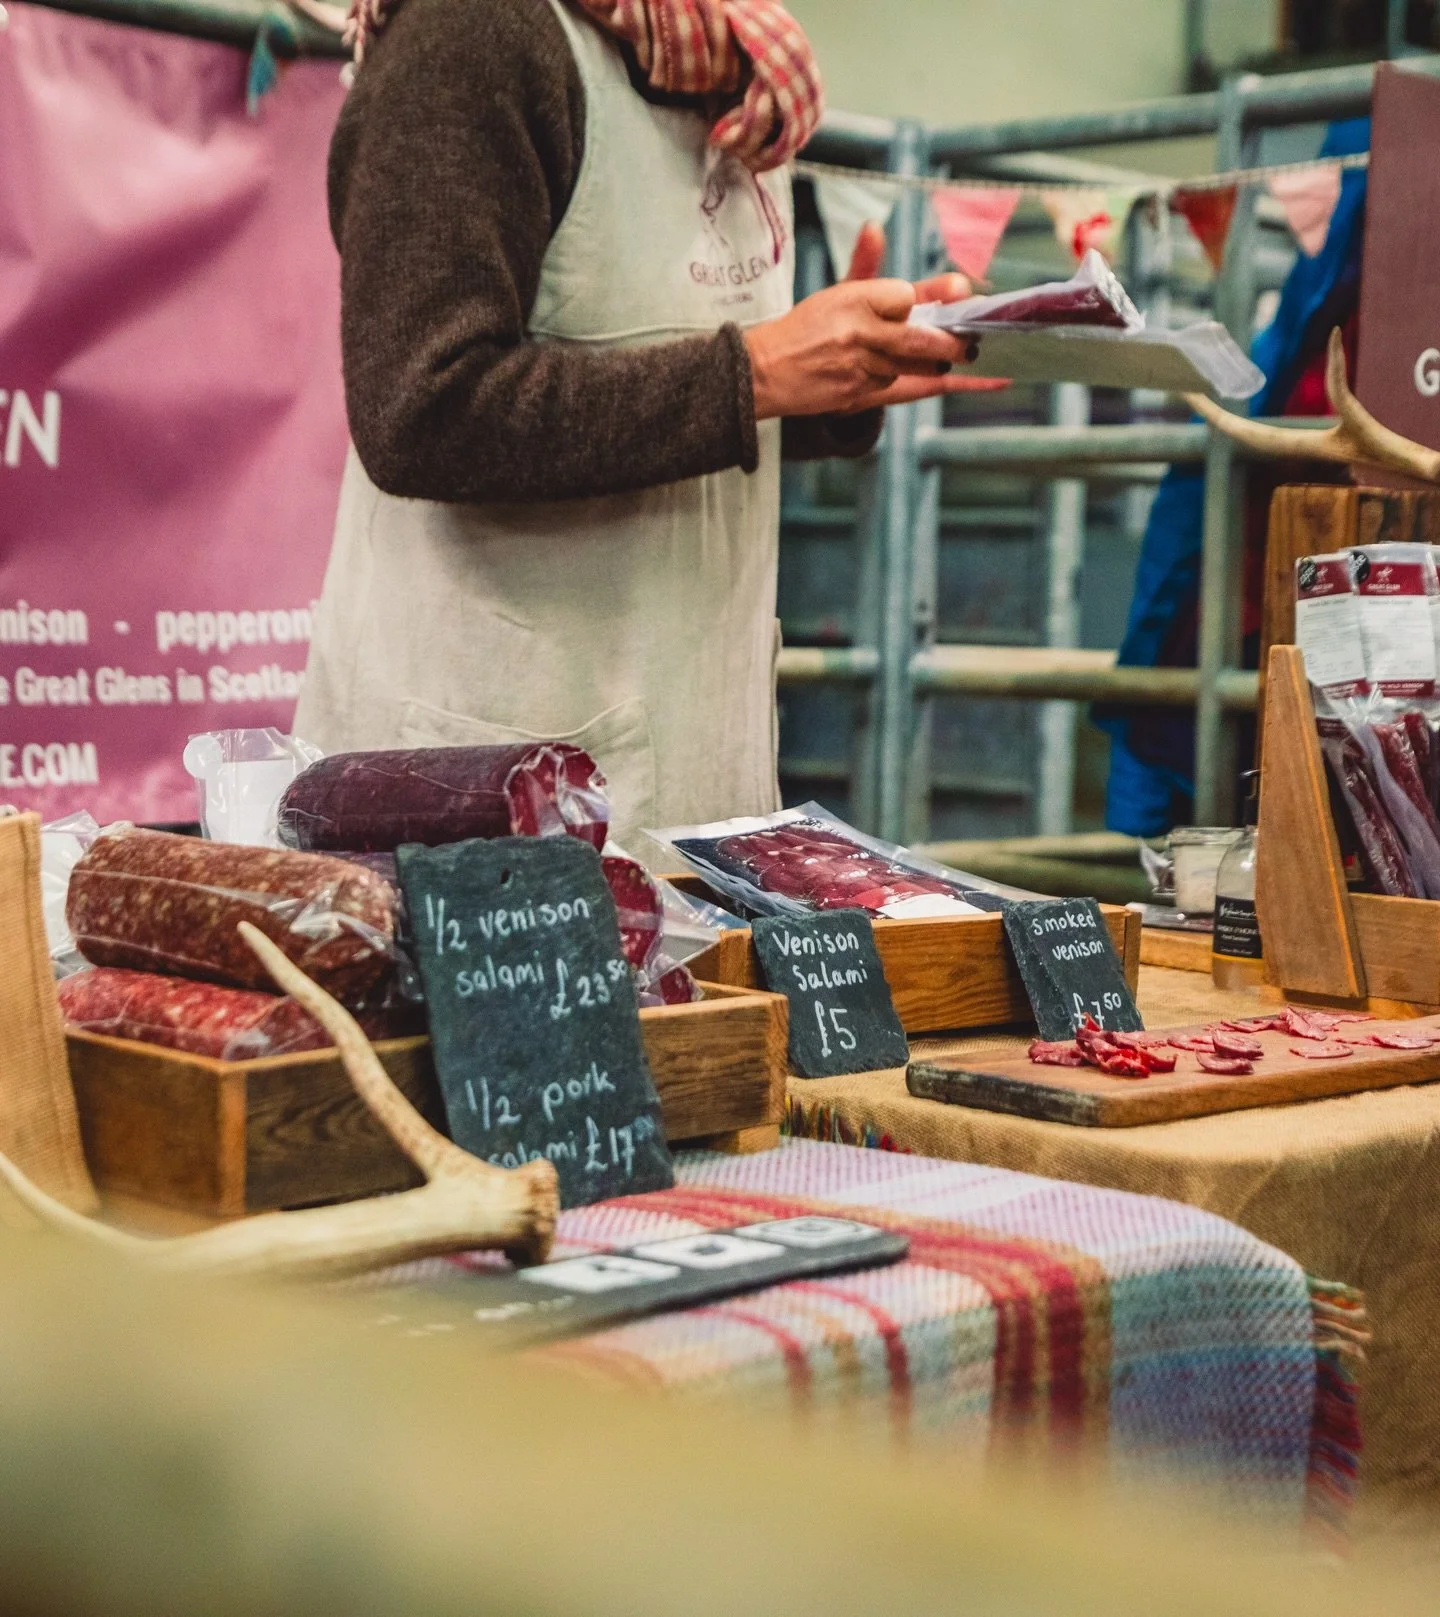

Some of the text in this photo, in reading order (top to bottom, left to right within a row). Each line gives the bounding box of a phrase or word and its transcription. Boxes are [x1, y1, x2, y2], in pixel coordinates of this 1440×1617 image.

[15, 666, 91, 706] Great
[95, 666, 172, 704] Glens
[177, 667, 205, 704] in
[479, 896, 589, 940] venison
[772, 929, 859, 956] Venison
[1052, 939, 1105, 960] venison
[455, 950, 545, 997] salami
[792, 960, 868, 992] Salami
[815, 1000, 857, 1057] £5
[542, 1061, 617, 1122] pork
